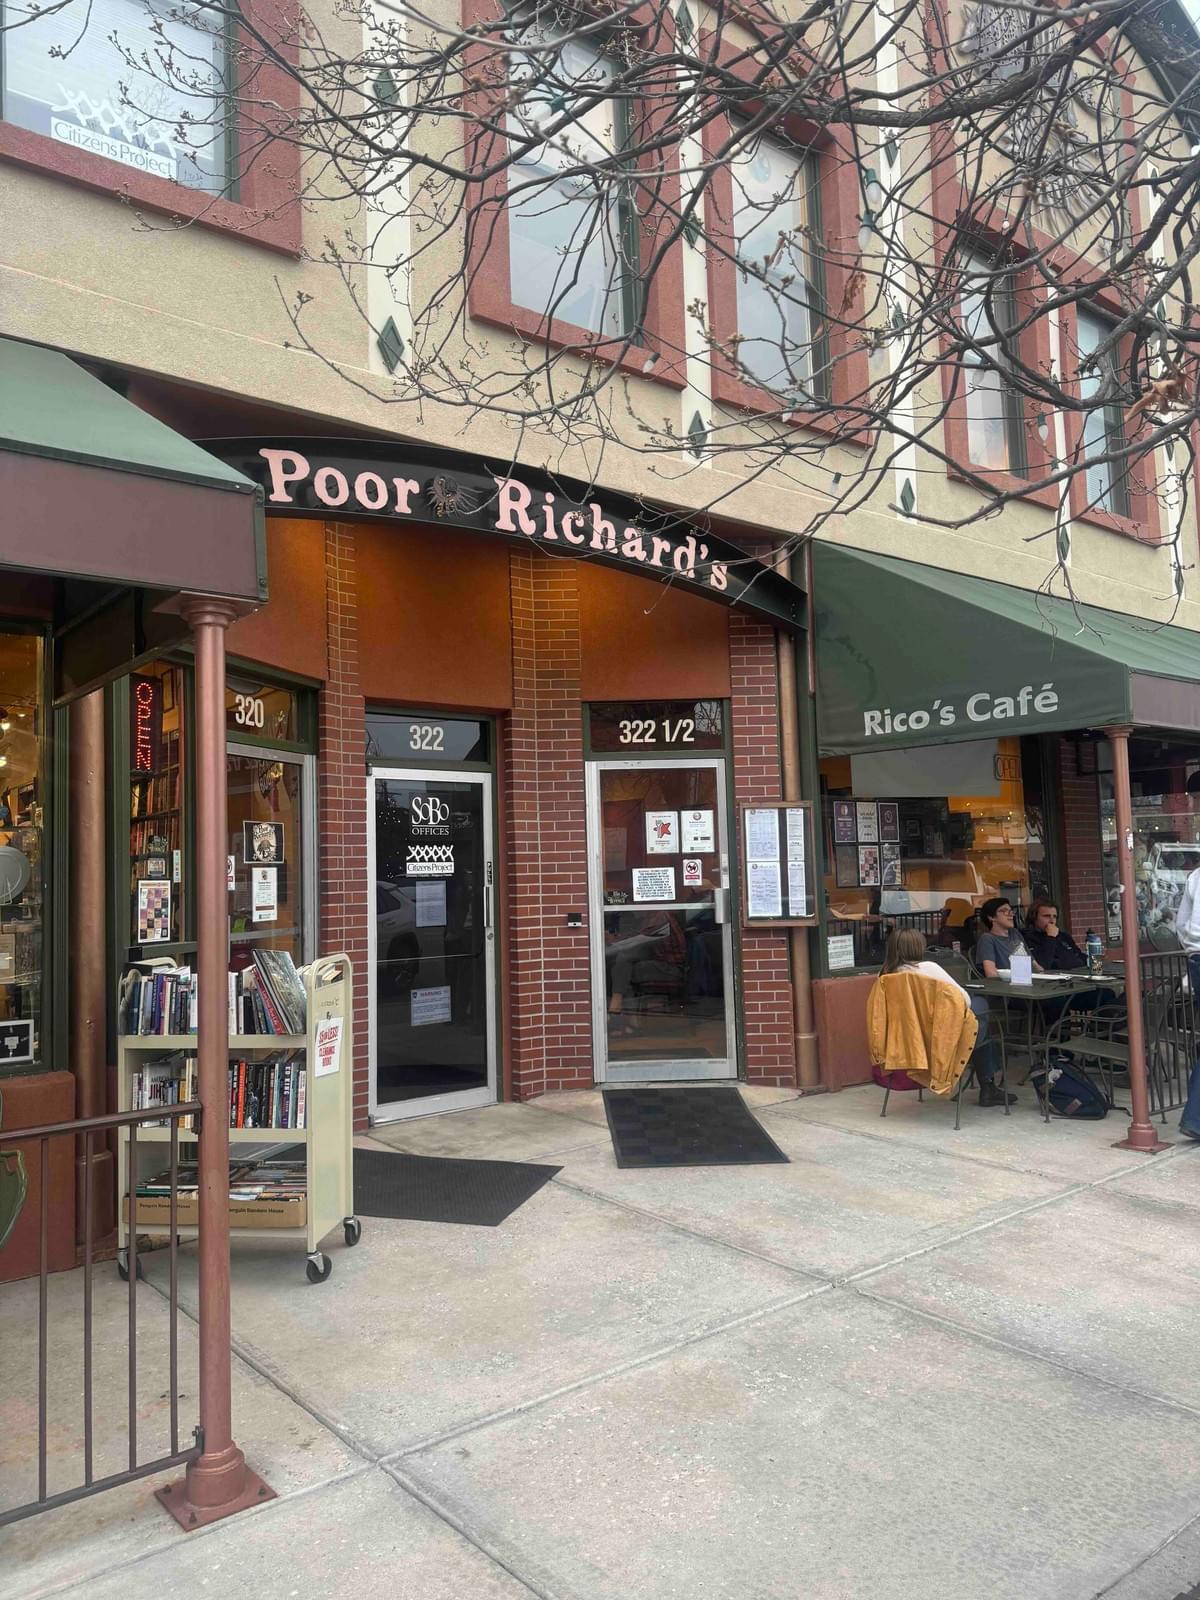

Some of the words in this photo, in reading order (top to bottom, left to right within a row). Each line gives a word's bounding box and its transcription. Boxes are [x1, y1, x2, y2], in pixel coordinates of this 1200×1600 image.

[54, 121, 118, 156] Citizens
[119, 145, 173, 175] Project
[258, 448, 420, 514] Poor
[493, 476, 728, 591] Richard's
[136, 682, 153, 770] OPEN
[235, 694, 264, 728] 320
[863, 700, 956, 736] Rico's
[966, 682, 1059, 722] Café
[409, 725, 445, 751] 322
[619, 719, 656, 743] 322
[661, 718, 695, 742] 1/2
[411, 827, 450, 836] OFFICES
[407, 863, 432, 872] Citizens
[432, 863, 454, 873] Project
